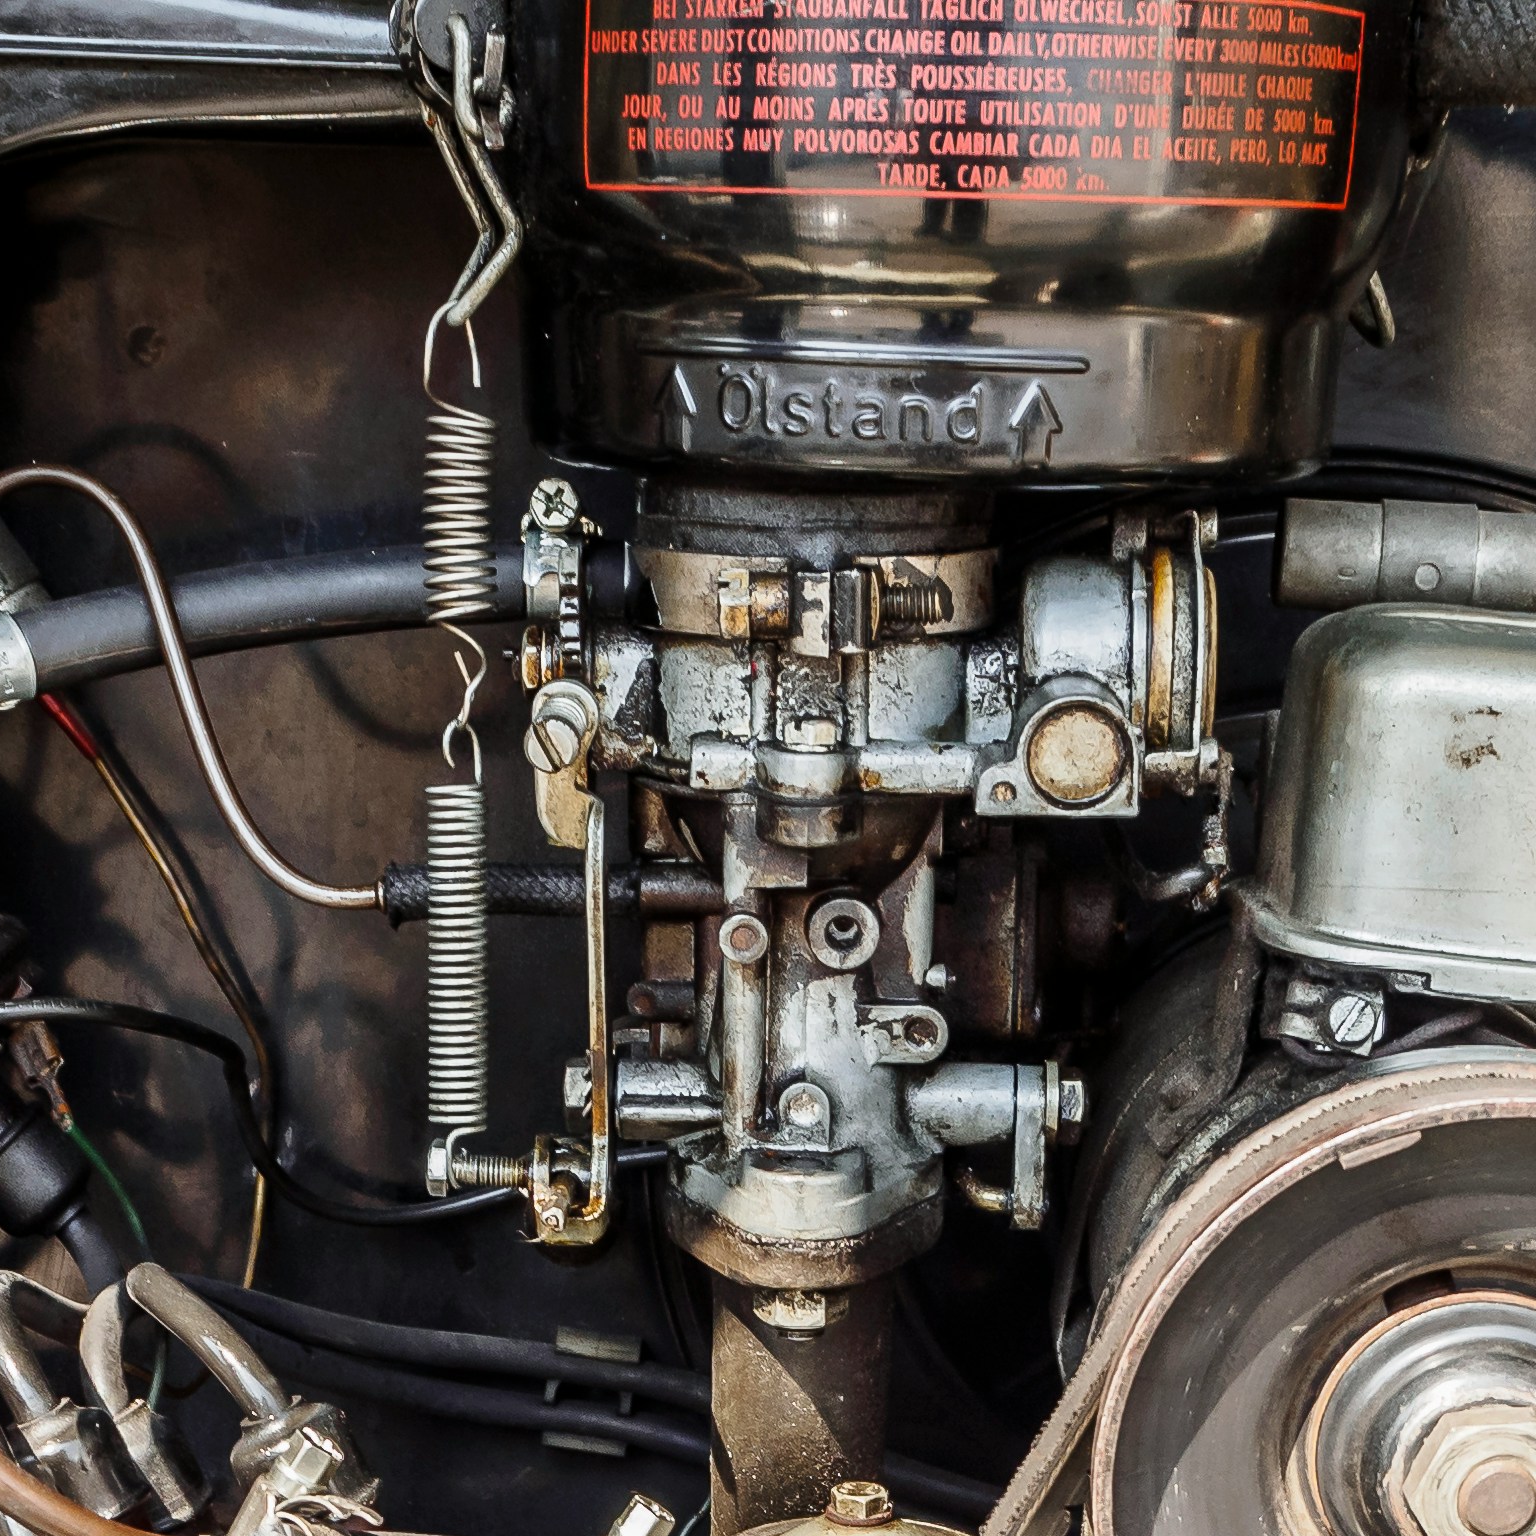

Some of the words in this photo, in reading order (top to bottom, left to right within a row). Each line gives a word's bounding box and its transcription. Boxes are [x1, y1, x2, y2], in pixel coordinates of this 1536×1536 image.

[653, 0, 677, 20] BEI
[774, 0, 909, 20] STAUBANFALL
[1201, 4, 1239, 30] ALLE
[1247, 8, 1282, 33] 5000
[591, 29, 638, 54] UNDER
[641, 28, 697, 54] SEVERE
[701, 28, 745, 53] DUST
[747, 27, 860, 54] CONDITIONS
[864, 28, 946, 56] CHANGE
[950, 30, 983, 56] OIL
[1165, 36, 1216, 63] EVERY
[1220, 38, 1258, 65] 3000
[1259, 41, 1299, 68] MILES
[656, 60, 701, 87] DANS
[712, 61, 742, 87] LES
[755, 55, 837, 90] RÉGIONS
[1086, 68, 1174, 96] CHANGER
[1184, 71, 1247, 98] L'HUILE
[1256, 74, 1313, 101] CHAQUE
[621, 94, 667, 122] JOUR,
[677, 94, 704, 119] OU
[715, 95, 741, 120] AU
[752, 95, 815, 122] MOINS
[903, 97, 967, 126] TOUTE
[980, 99, 1102, 129] UTILISATION
[1114, 102, 1171, 130] D'UNE
[1181, 100, 1235, 132] DURÉE
[1244, 107, 1265, 133] DE
[1272, 107, 1306, 134] 5000
[628, 127, 647, 151] EN
[654, 127, 735, 152] REGIONES
[742, 128, 785, 153] MUY
[793, 127, 920, 155] POLVOROSAS
[929, 130, 1019, 158] CAMBIAR
[1028, 132, 1081, 160] CADA
[1090, 134, 1124, 161] DIA
[1133, 135, 1152, 162] EL
[1161, 136, 1222, 167] ACEITE,
[1229, 137, 1271, 167] PERO,
[1278, 139, 1297, 165] LO
[876, 162, 947, 191] TARDE,
[957, 163, 1012, 190] CADA
[1020, 165, 1069, 192] 5000
[717, 360, 985, 445] Ölstand
